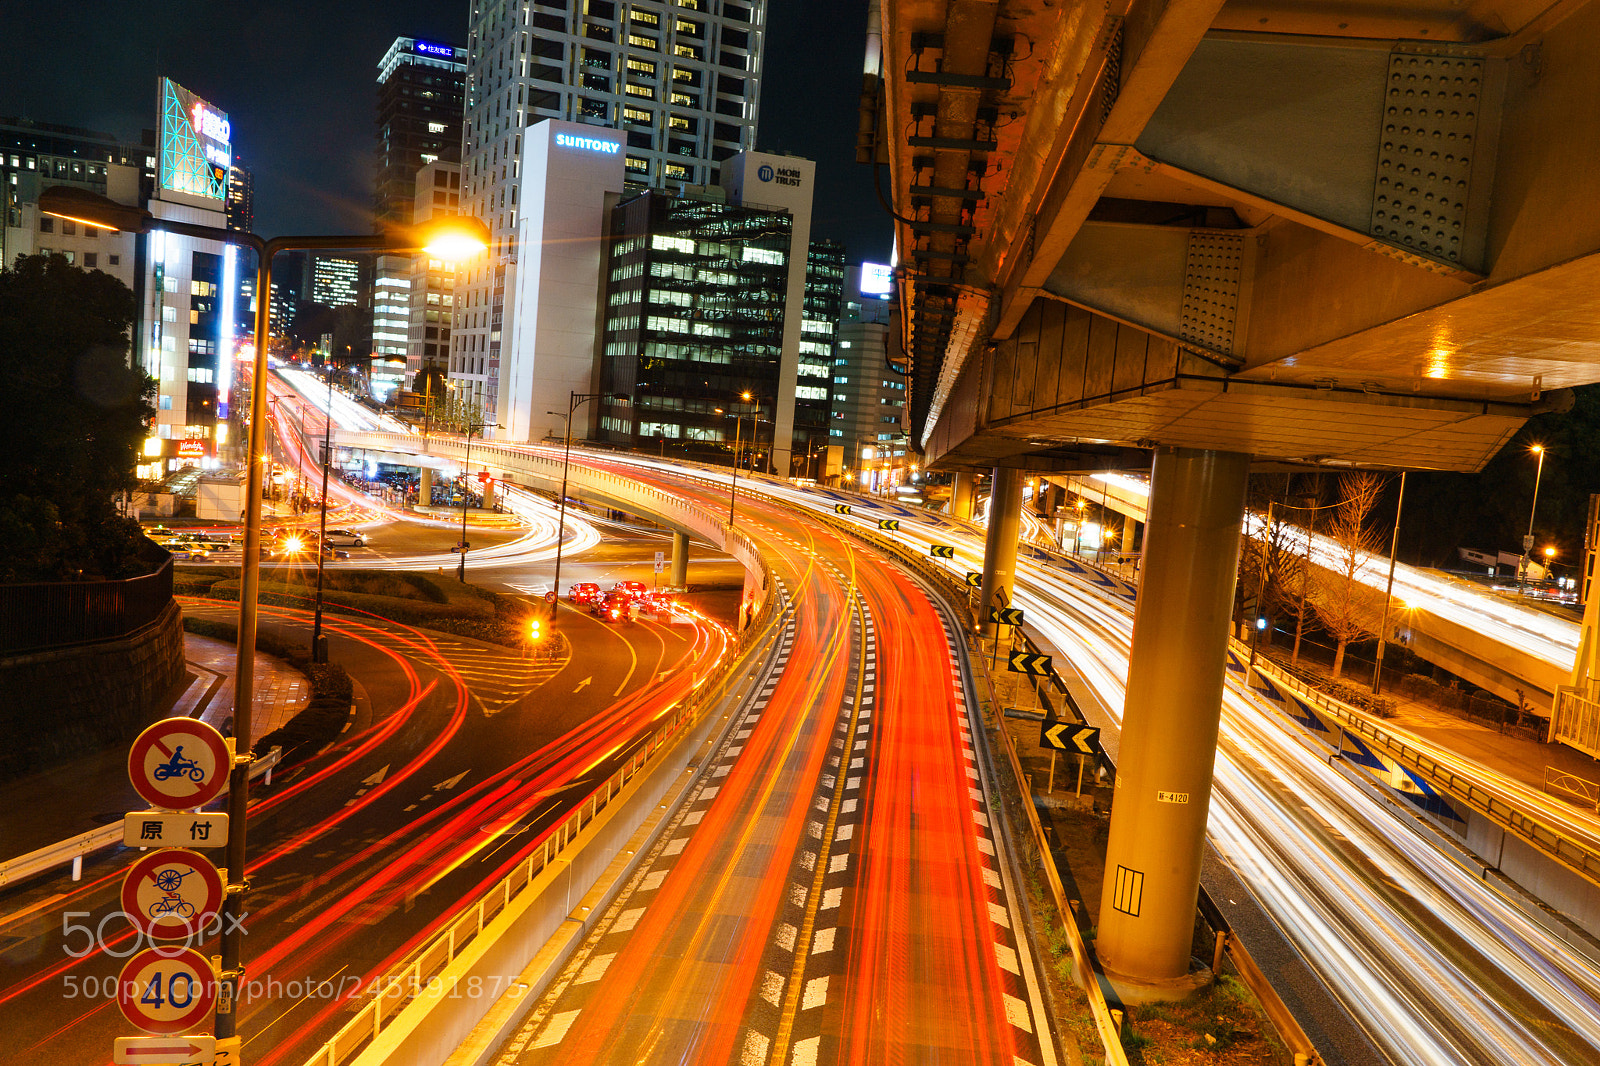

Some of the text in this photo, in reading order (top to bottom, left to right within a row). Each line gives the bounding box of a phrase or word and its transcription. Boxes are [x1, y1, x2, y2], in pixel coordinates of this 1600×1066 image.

[556, 134, 620, 154] SUNTORY
[776, 167, 801, 179] MORI
[775, 175, 802, 188] TRUST
[141, 971, 194, 1009] 40
